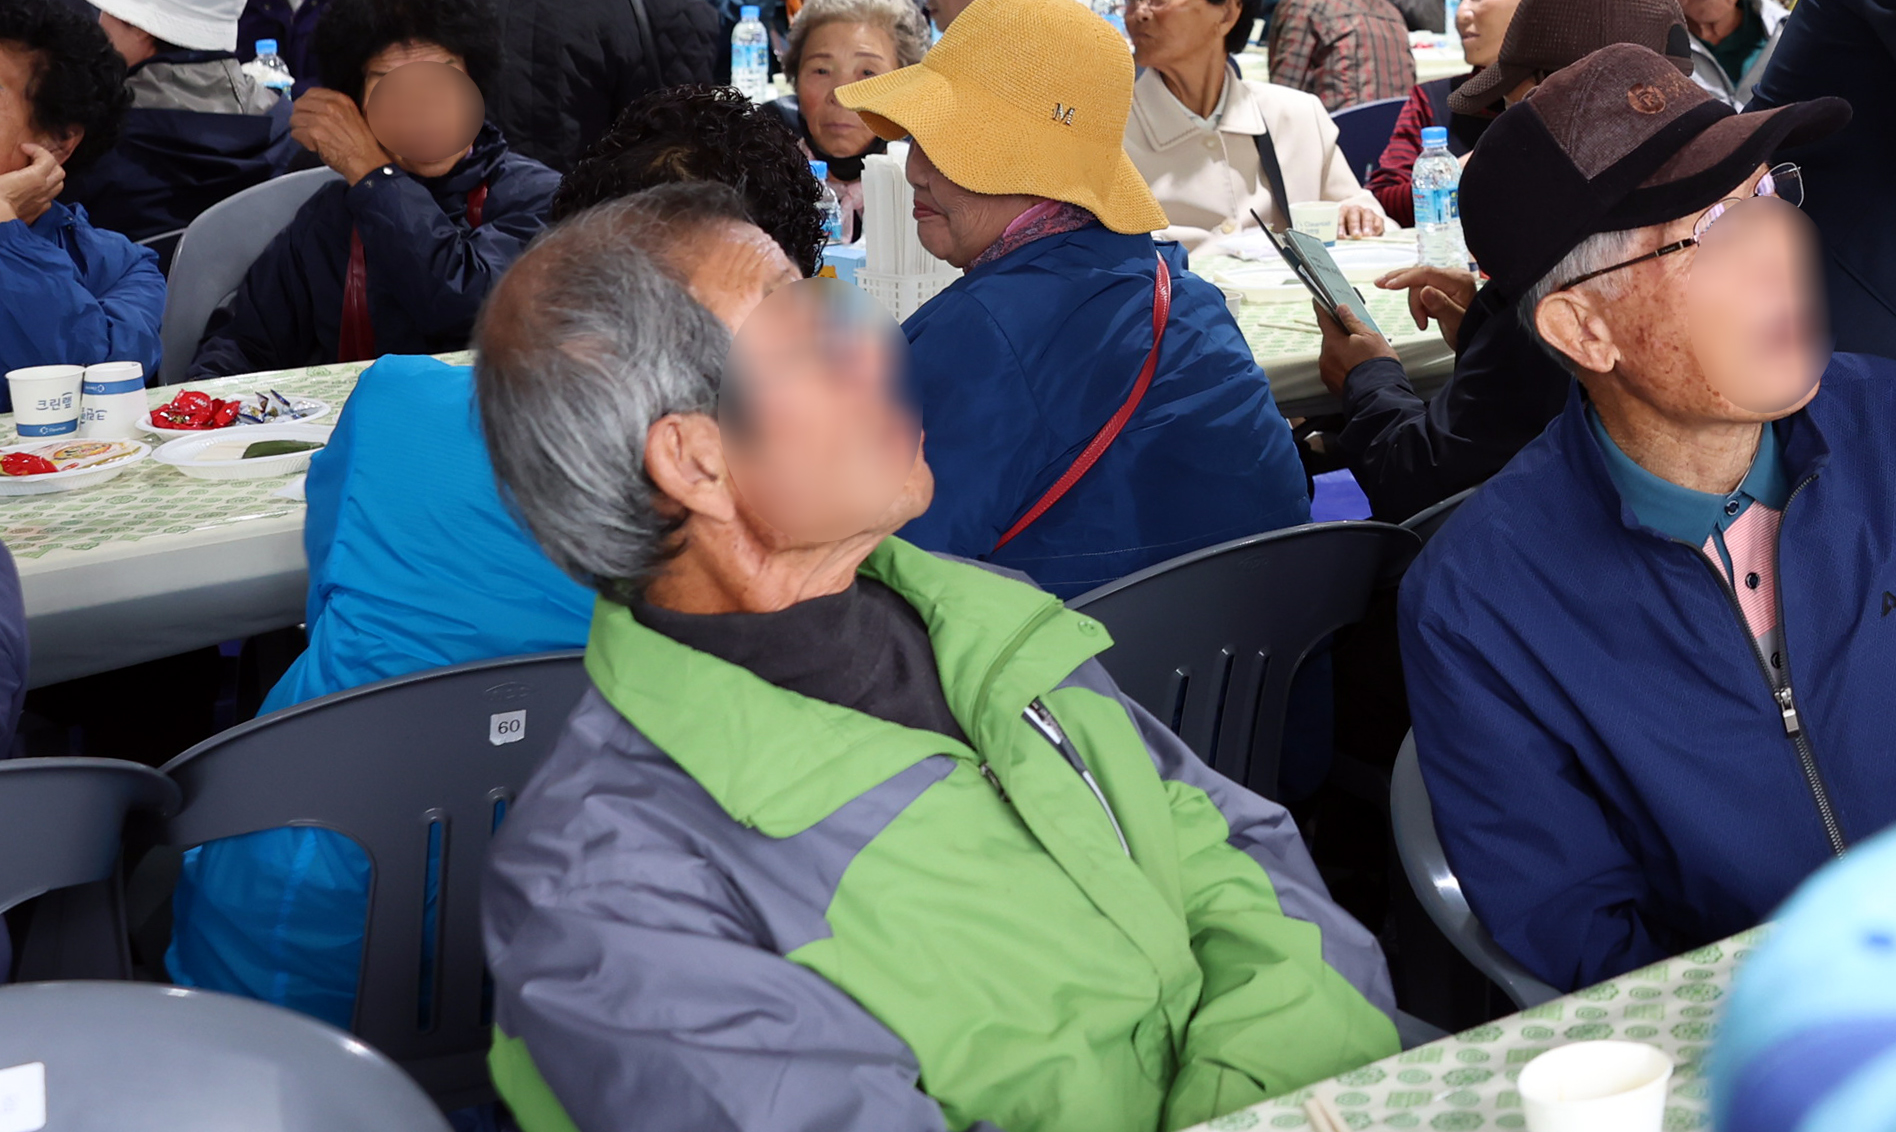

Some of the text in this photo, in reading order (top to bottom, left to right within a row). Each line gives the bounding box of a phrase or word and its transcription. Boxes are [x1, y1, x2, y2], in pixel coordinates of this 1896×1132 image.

[1052, 102, 1075, 126] M
[36, 391, 73, 411] 크린랩
[498, 719, 520, 734] 60
